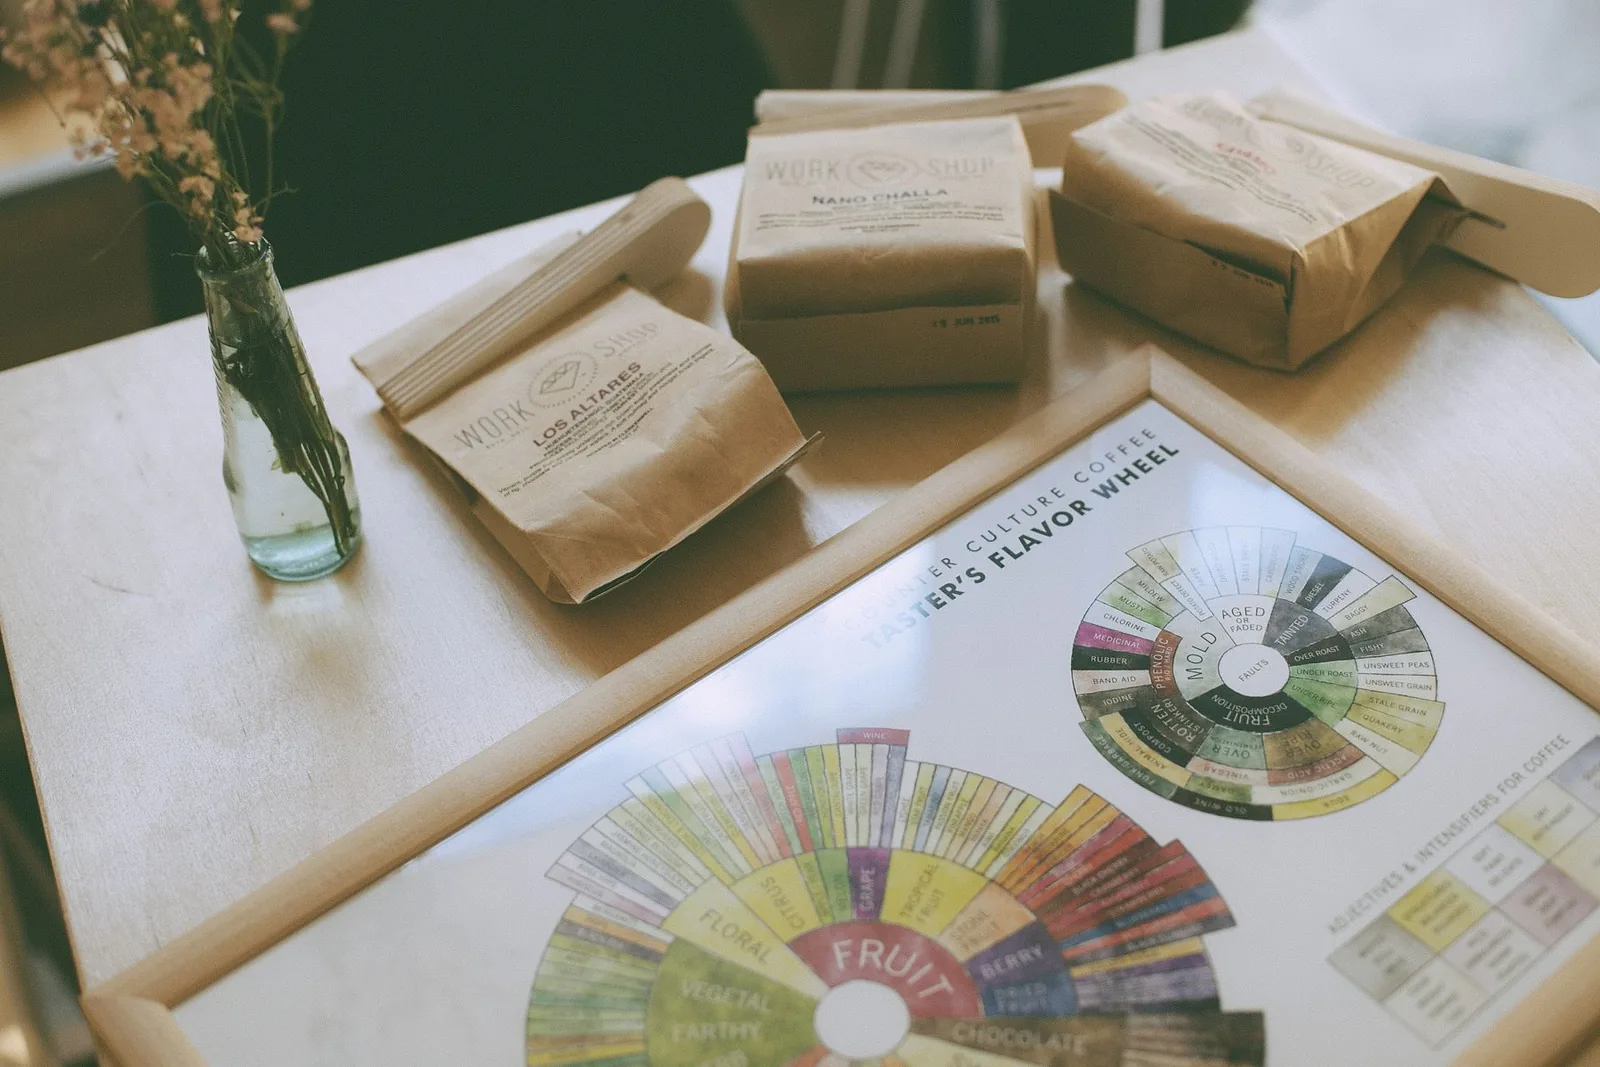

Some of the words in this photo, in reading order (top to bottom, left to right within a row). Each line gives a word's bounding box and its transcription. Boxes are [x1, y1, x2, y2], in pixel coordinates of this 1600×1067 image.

[766, 159, 841, 181] WORK
[928, 157, 995, 177] SHOP
[812, 195, 867, 205] NANO
[872, 188, 949, 201] CHALLA
[454, 400, 535, 449] WORK
[594, 322, 658, 357] SHOP
[533, 419, 568, 447] LOS
[570, 362, 642, 421] ALTARES
[966, 486, 1066, 554] CULTURE
[1074, 428, 1157, 484] COFFEE
[862, 566, 987, 649] TASTER'S
[987, 499, 1093, 569] FLAVOR
[1091, 444, 1181, 500] WHEEL
[1137, 580, 1165, 603] MILDEW
[1305, 582, 1325, 603] DIESEL
[1323, 588, 1352, 613] TURPENY
[1119, 595, 1146, 612] MUSTY
[1222, 607, 1266, 620] AGED
[1344, 605, 1369, 621] BAGGY
[1104, 613, 1146, 632] CHLORINE
[1230, 624, 1263, 633] FADED
[1274, 615, 1309, 646] TAINTED
[1350, 627, 1367, 638] ASH
[1093, 633, 1141, 649] MEDICINAL
[1360, 642, 1385, 653] FISHY
[1090, 655, 1128, 665] RUBBER
[1153, 637, 1170, 689] PHENOLIC
[1186, 632, 1217, 680] MOLD
[1293, 650, 1314, 662] OVER
[1315, 645, 1340, 657] ROAST
[1238, 659, 1269, 682] FAULTS
[1297, 669, 1325, 677] UNDER
[1328, 670, 1353, 678] ROAST
[1364, 661, 1404, 669] UNSWEET
[1408, 661, 1430, 669] PEAS
[1093, 677, 1118, 685] BAND
[1121, 675, 1137, 683] AID
[1365, 679, 1404, 689] UNSWEET
[1406, 683, 1432, 692] GRAIN
[1102, 693, 1133, 706] IODINE
[1211, 694, 1288, 715] DECOMPOSITION
[1369, 696, 1395, 709] STALE
[1397, 704, 1427, 716] GRAIN
[1150, 704, 1196, 743] ROTTEN
[1162, 698, 1204, 734] (STINKER)
[1223, 711, 1270, 726] FRUIT
[1363, 714, 1404, 734] QUAKERY
[862, 731, 887, 740] WINE
[1115, 727, 1133, 746] HIDE
[1134, 722, 1171, 753] COMPOST
[1350, 730, 1370, 744] RAW
[1371, 743, 1389, 756] NUT
[1135, 745, 1166, 770] ANIMAL
[1212, 745, 1250, 759] OVER
[1285, 740, 1321, 758] OVER
[1203, 765, 1248, 779] VINEGAR
[1316, 754, 1349, 770] ACETIC
[1288, 767, 1315, 779] ACID
[1413, 793, 1499, 864] INTENSIFIERS
[1497, 769, 1523, 797] FOR
[1522, 733, 1572, 774] COFFEE
[859, 866, 876, 912] GRAPE
[760, 876, 806, 931] CITRUS
[699, 907, 772, 965] FLORAL
[833, 939, 954, 998] FRUIT
[980, 945, 1045, 980] BERRY
[681, 978, 771, 1013] VEGETAL
[671, 1021, 762, 1044] EARTHY
[951, 1021, 1086, 1055] CHOCOLATE
